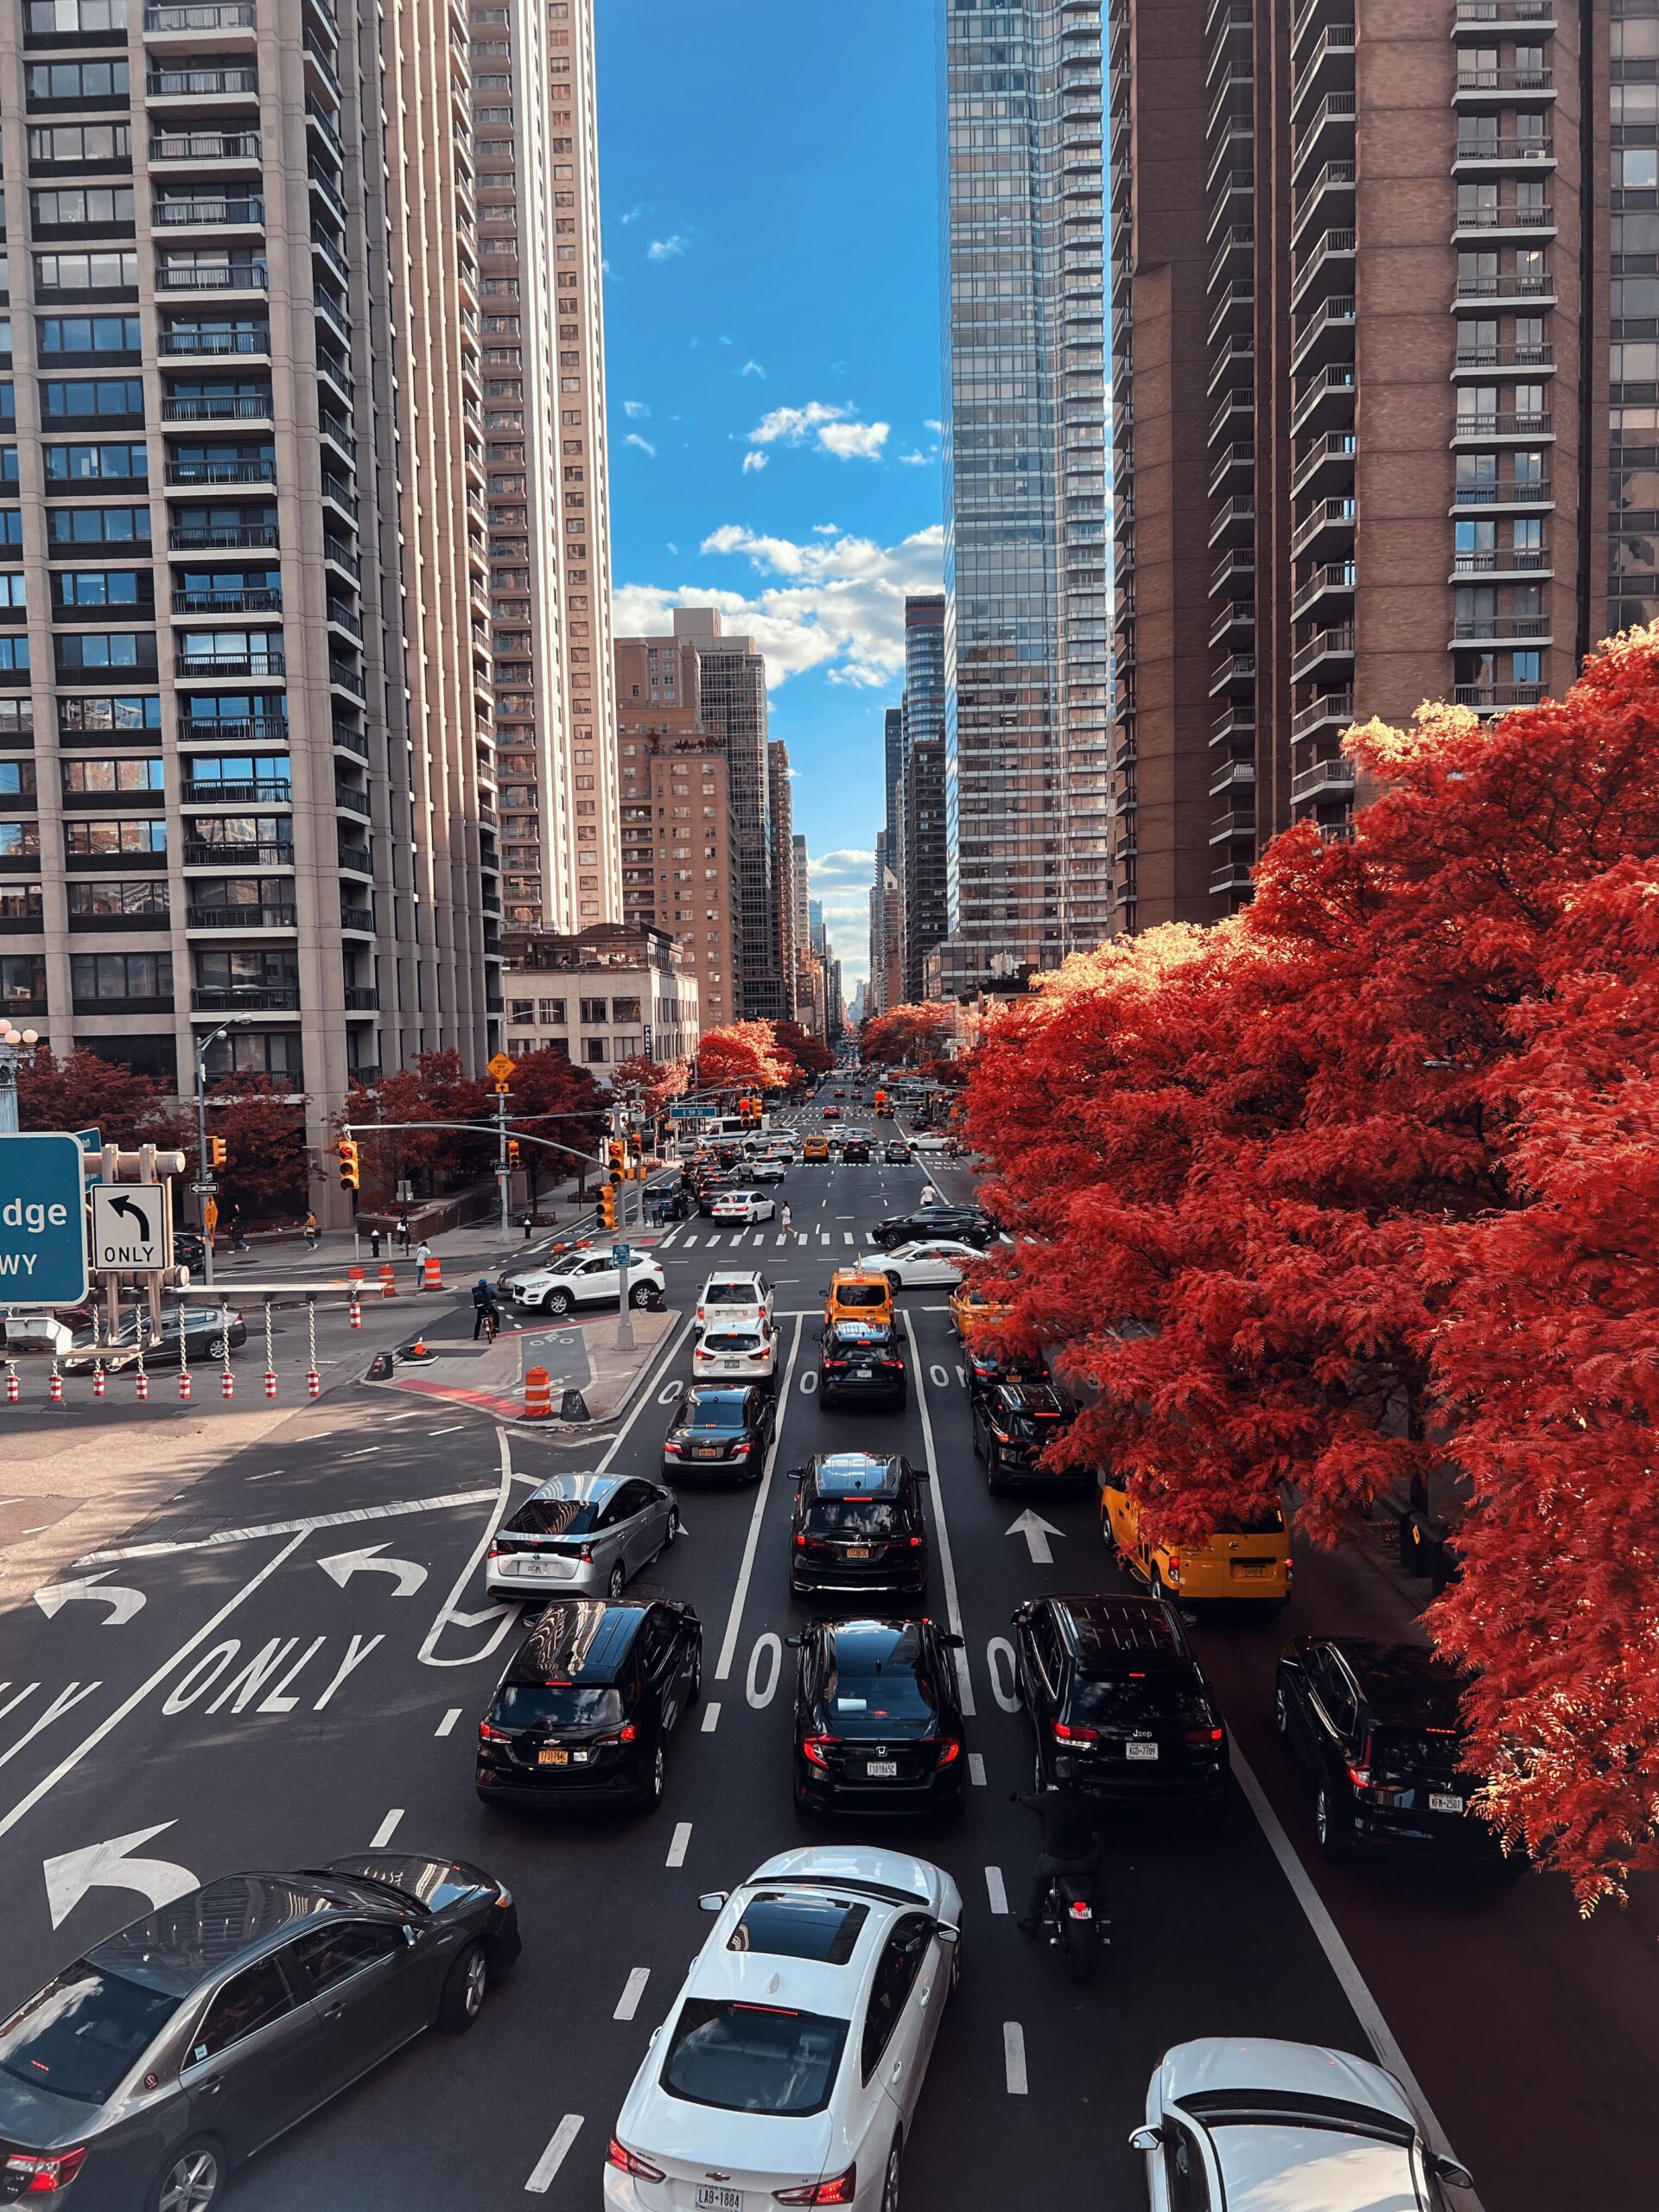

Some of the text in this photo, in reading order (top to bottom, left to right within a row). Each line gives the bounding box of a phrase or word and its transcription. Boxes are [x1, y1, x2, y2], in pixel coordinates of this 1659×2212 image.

[105, 1247, 155, 1262] ONLY
[162, 1633, 386, 1716] ONLY
[1133, 1729, 1152, 1738] Jeep
